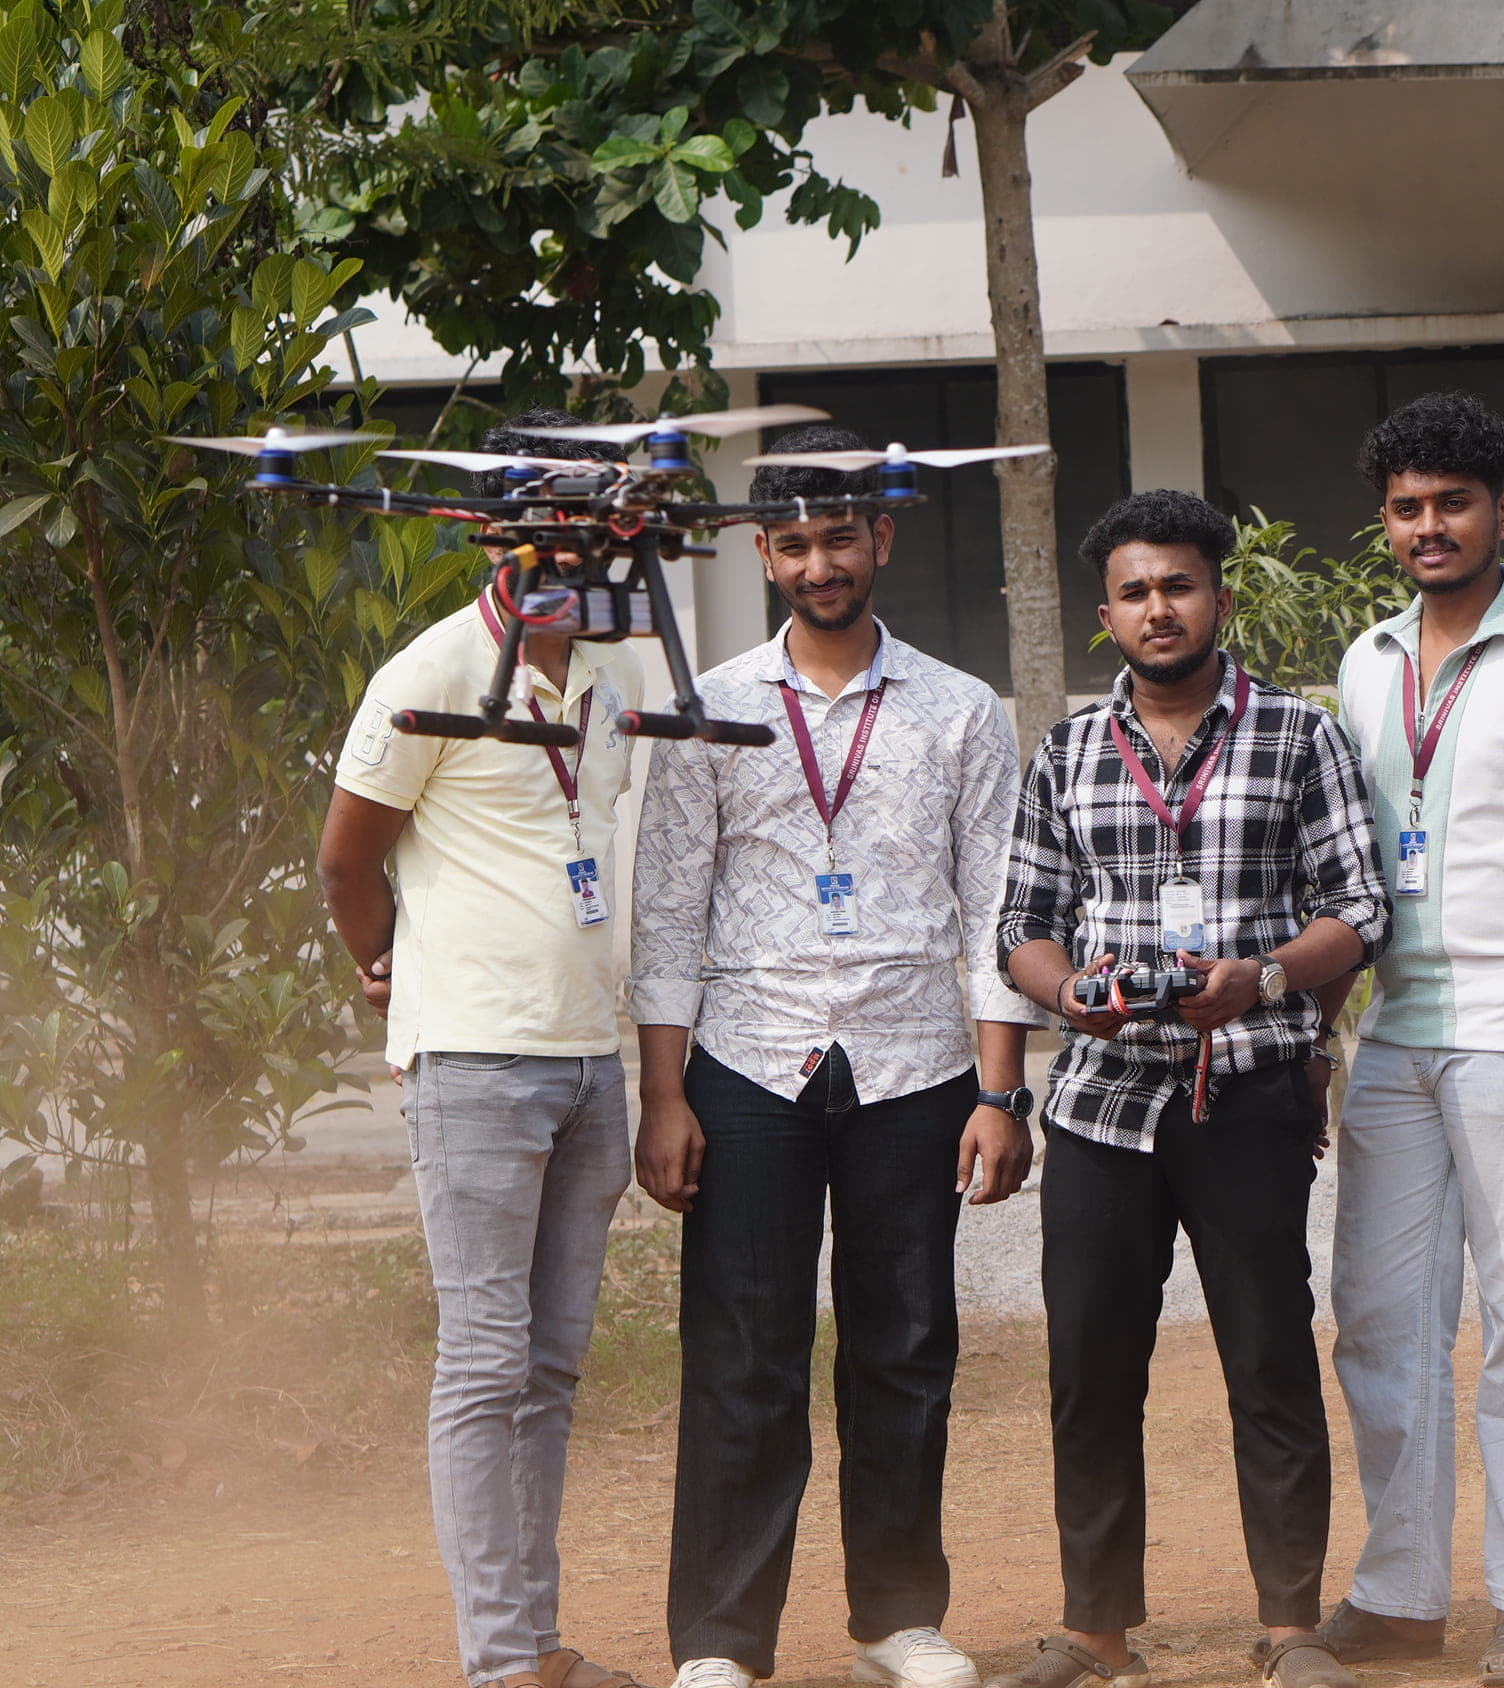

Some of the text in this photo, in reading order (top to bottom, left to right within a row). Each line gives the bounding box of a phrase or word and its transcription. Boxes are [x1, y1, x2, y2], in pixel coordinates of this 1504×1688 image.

[1436, 694, 1455, 731] SRINIVAS
[1452, 656, 1477, 695] INSTITUTE
[846, 744, 865, 780] SRINIVAS
[858, 703, 878, 743] INSTITUTE
[1195, 754, 1216, 791] SRINIVAS
